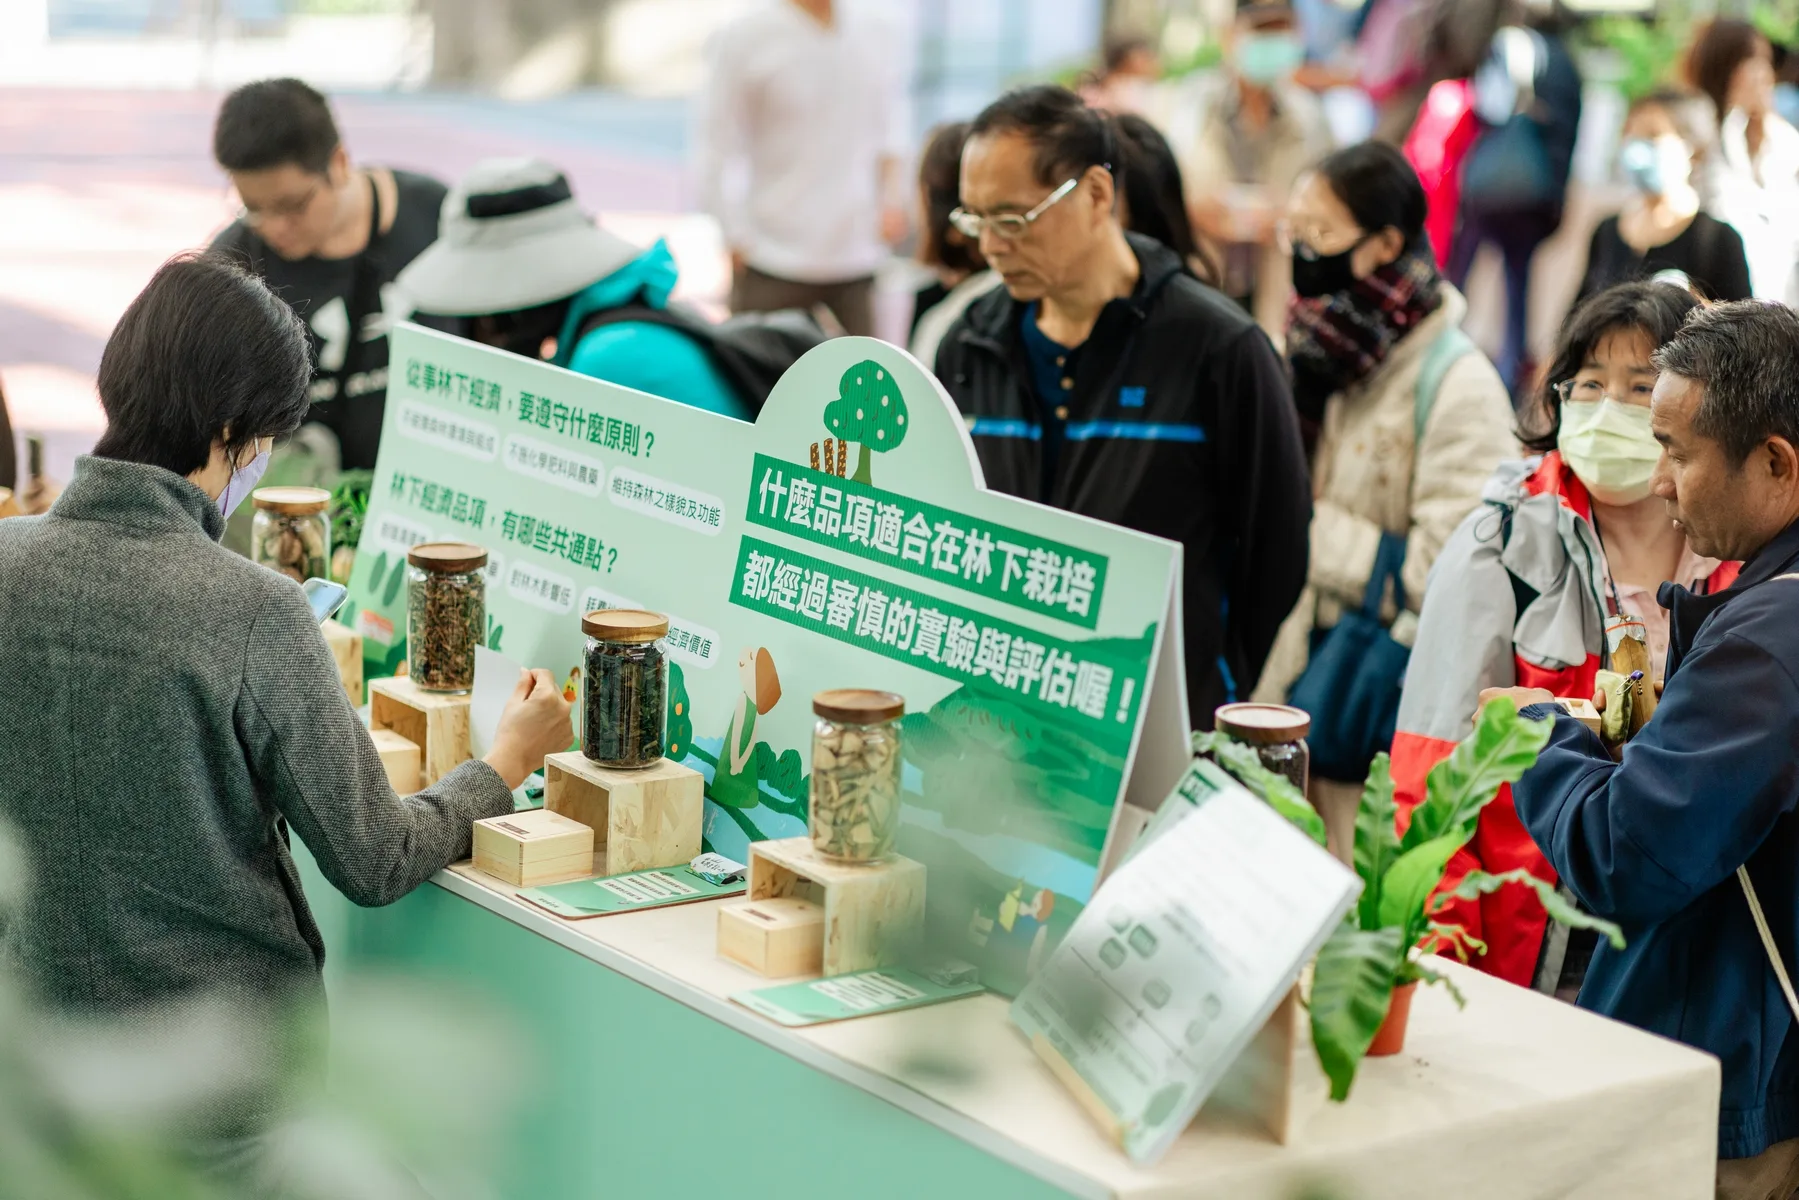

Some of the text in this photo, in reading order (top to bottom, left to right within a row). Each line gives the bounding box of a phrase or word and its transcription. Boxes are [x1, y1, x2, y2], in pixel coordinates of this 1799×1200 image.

[406, 358, 655, 458] 從事林下經濟，要遵守什麼原則？
[390, 470, 618, 573] 林下經濟品項，有哪些共通點？
[611, 475, 721, 527] 維持森林之樣貌及功能
[758, 467, 1097, 618] 什麼品項適合在林下栽培
[741, 550, 1136, 724] 都經過審慎的實驗與評估喔！
